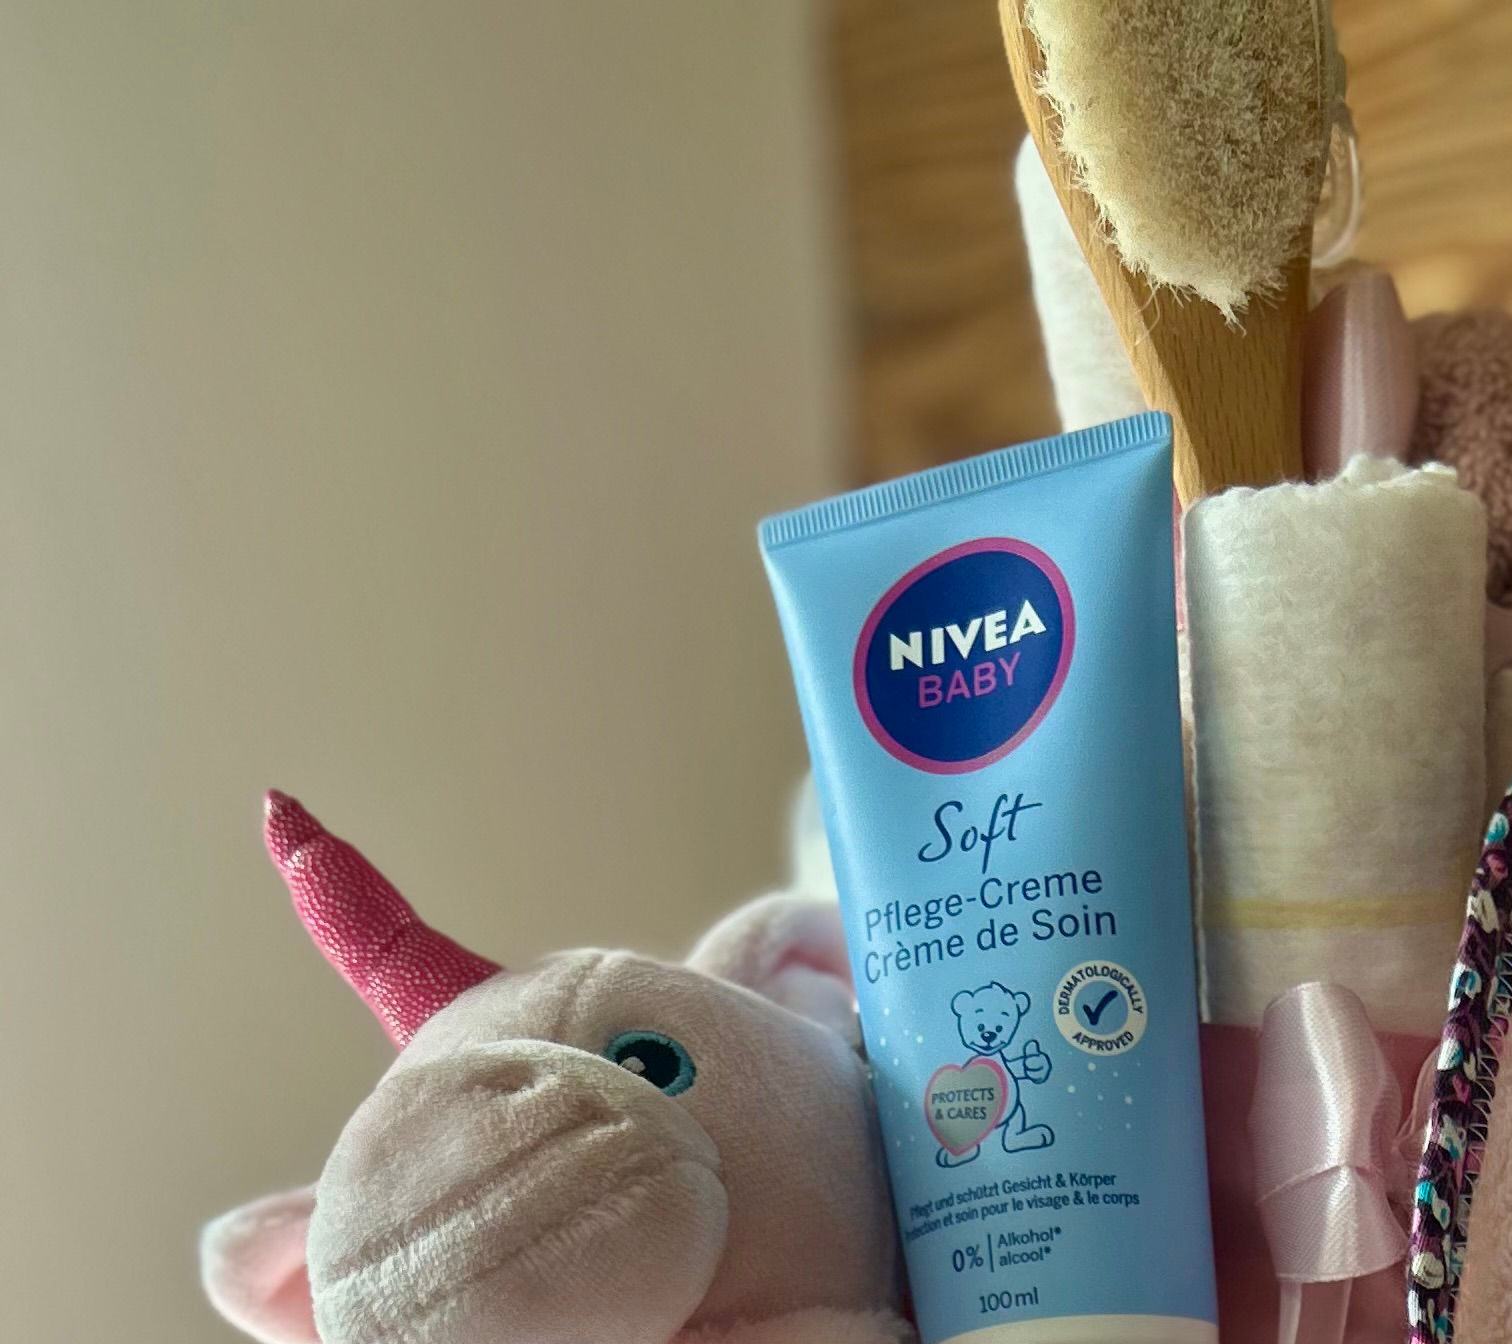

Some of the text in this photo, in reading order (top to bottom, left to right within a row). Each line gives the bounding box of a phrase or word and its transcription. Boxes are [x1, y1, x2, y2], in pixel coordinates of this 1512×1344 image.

[889, 599, 1047, 671] NIVEA
[918, 652, 1022, 709] BABY
[917, 793, 1043, 874] Soft
[864, 868, 1103, 943] Pflege-Creme
[864, 905, 1118, 985] Crème de Soin
[1058, 964, 1144, 1016] DERMATOLOGICALLY
[1072, 1031, 1135, 1051] APPROVED
[931, 1087, 995, 1105] PROTECTS
[935, 1106, 987, 1121] & CARES
[935, 1192, 954, 1211] und
[956, 1182, 999, 1205] schützt
[1002, 1174, 1052, 1194] Gesicht
[1055, 1173, 1067, 1188] &
[1069, 1171, 1117, 1189] Körper
[943, 1212, 954, 1227] et
[955, 1207, 979, 1225] soin
[981, 1202, 1009, 1220] pour
[1012, 1196, 1024, 1211] le
[1028, 1192, 1070, 1210] visage
[1073, 1190, 1085, 1205] &
[1087, 1189, 1100, 1204] le
[1103, 1192, 1141, 1208] corps
[952, 1244, 985, 1273] 0%
